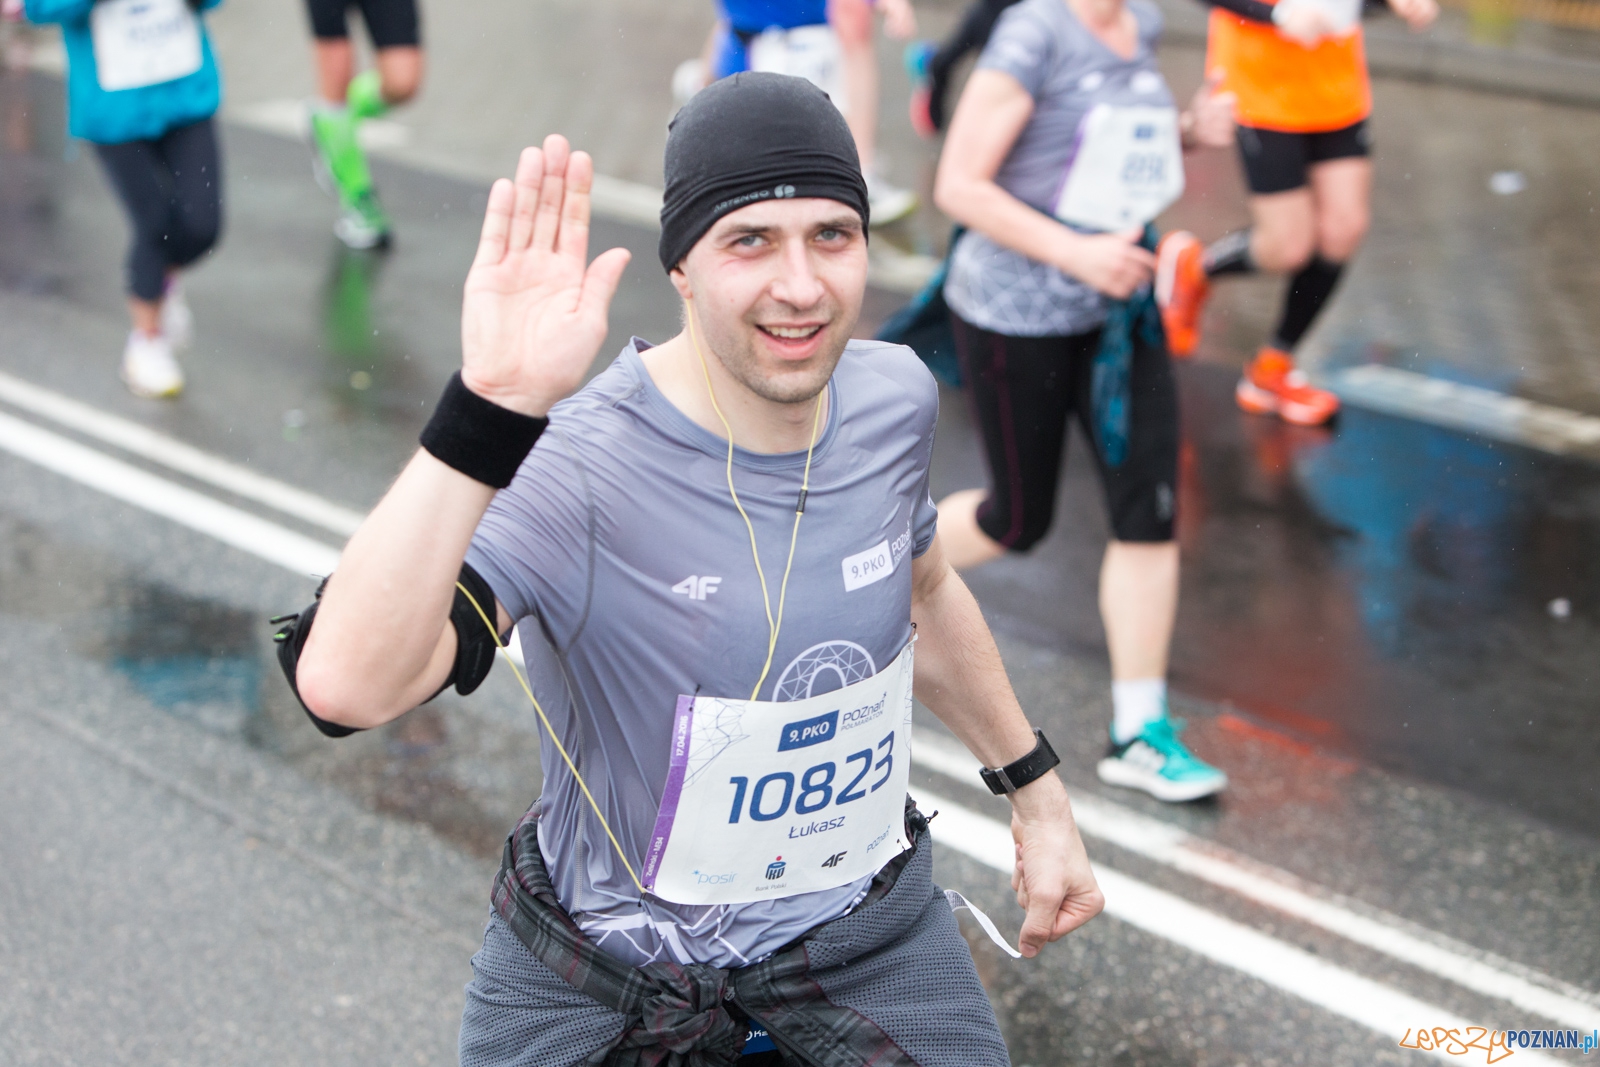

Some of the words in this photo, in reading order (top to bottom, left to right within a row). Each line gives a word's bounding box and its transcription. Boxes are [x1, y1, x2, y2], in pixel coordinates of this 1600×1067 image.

[713, 190, 770, 213] ARTENGO
[851, 565, 863, 579] 9.
[863, 554, 886, 575] PKO
[671, 574, 723, 601] 4F
[676, 715, 689, 757] 17.04.2016
[789, 729, 800, 743] 9.
[801, 721, 830, 741] PKO
[728, 730, 895, 824] 10823
[787, 816, 846, 839] Łukasz
[821, 850, 848, 868] 4F
